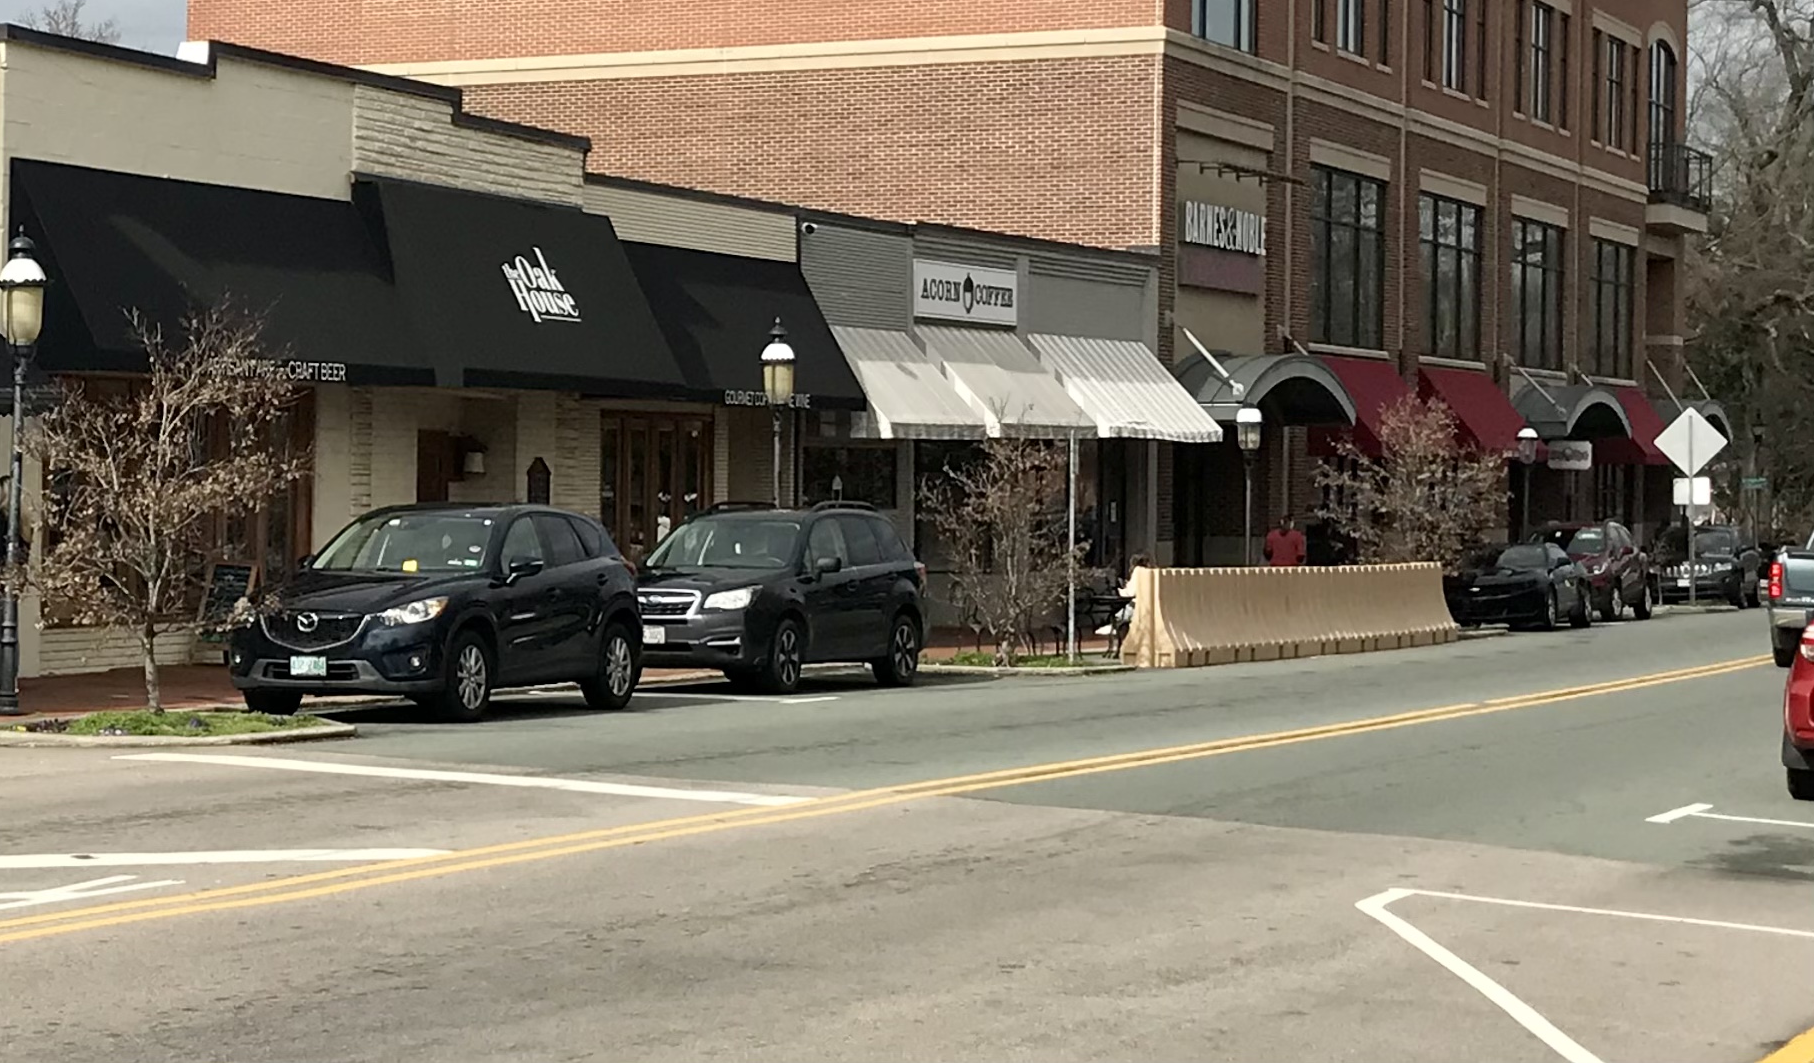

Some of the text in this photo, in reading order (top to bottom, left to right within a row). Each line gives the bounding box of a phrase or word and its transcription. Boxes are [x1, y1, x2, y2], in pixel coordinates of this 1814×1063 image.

[514, 247, 565, 292] Oak
[508, 278, 579, 323] House
[921, 277, 1014, 308] ACORN COFFEE
[288, 360, 319, 381] CRAFT
[320, 362, 346, 382] BEER
